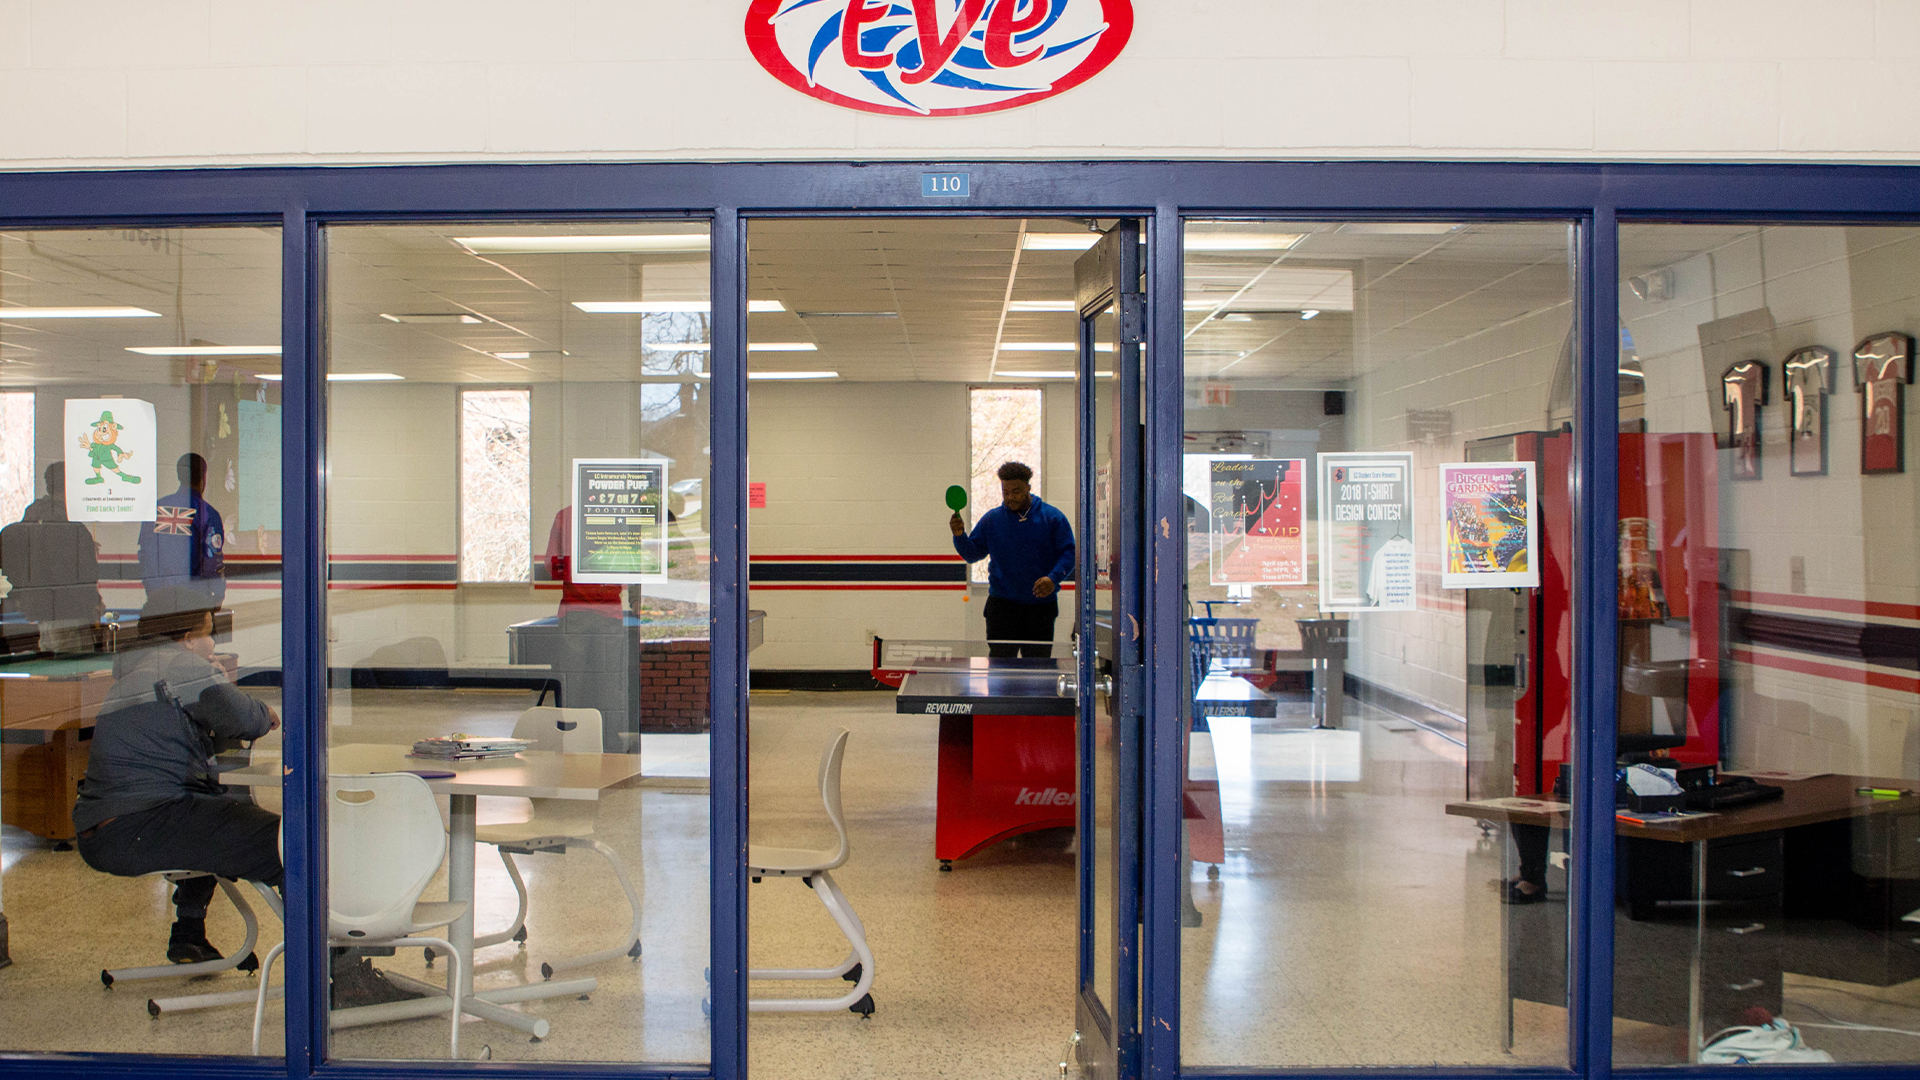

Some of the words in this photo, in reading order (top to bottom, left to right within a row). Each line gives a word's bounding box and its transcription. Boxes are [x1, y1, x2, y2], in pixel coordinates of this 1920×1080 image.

[931, 176, 961, 192] 110
[1205, 384, 1230, 404] EXIT
[1212, 462, 1255, 473] Leaders
[1228, 479, 1245, 487] the
[1455, 473, 1489, 484] BUSCH
[1492, 474, 1504, 482] April
[1341, 484, 1361, 500] 2018
[1363, 483, 1394, 500] T-SHIRT
[1447, 482, 1497, 494] GARDENS
[607, 493, 615, 504] 7
[617, 494, 629, 504] ON
[630, 493, 638, 504] 7
[1212, 492, 1235, 503] Red
[99, 505, 115, 513] Lucky
[1336, 504, 1364, 521] DESIGN
[1367, 503, 1402, 521] CONTEST
[886, 644, 952, 662] ESPN
[925, 703, 973, 715] REVOLUTION
[1203, 706, 1247, 717] KILLERSPIN
